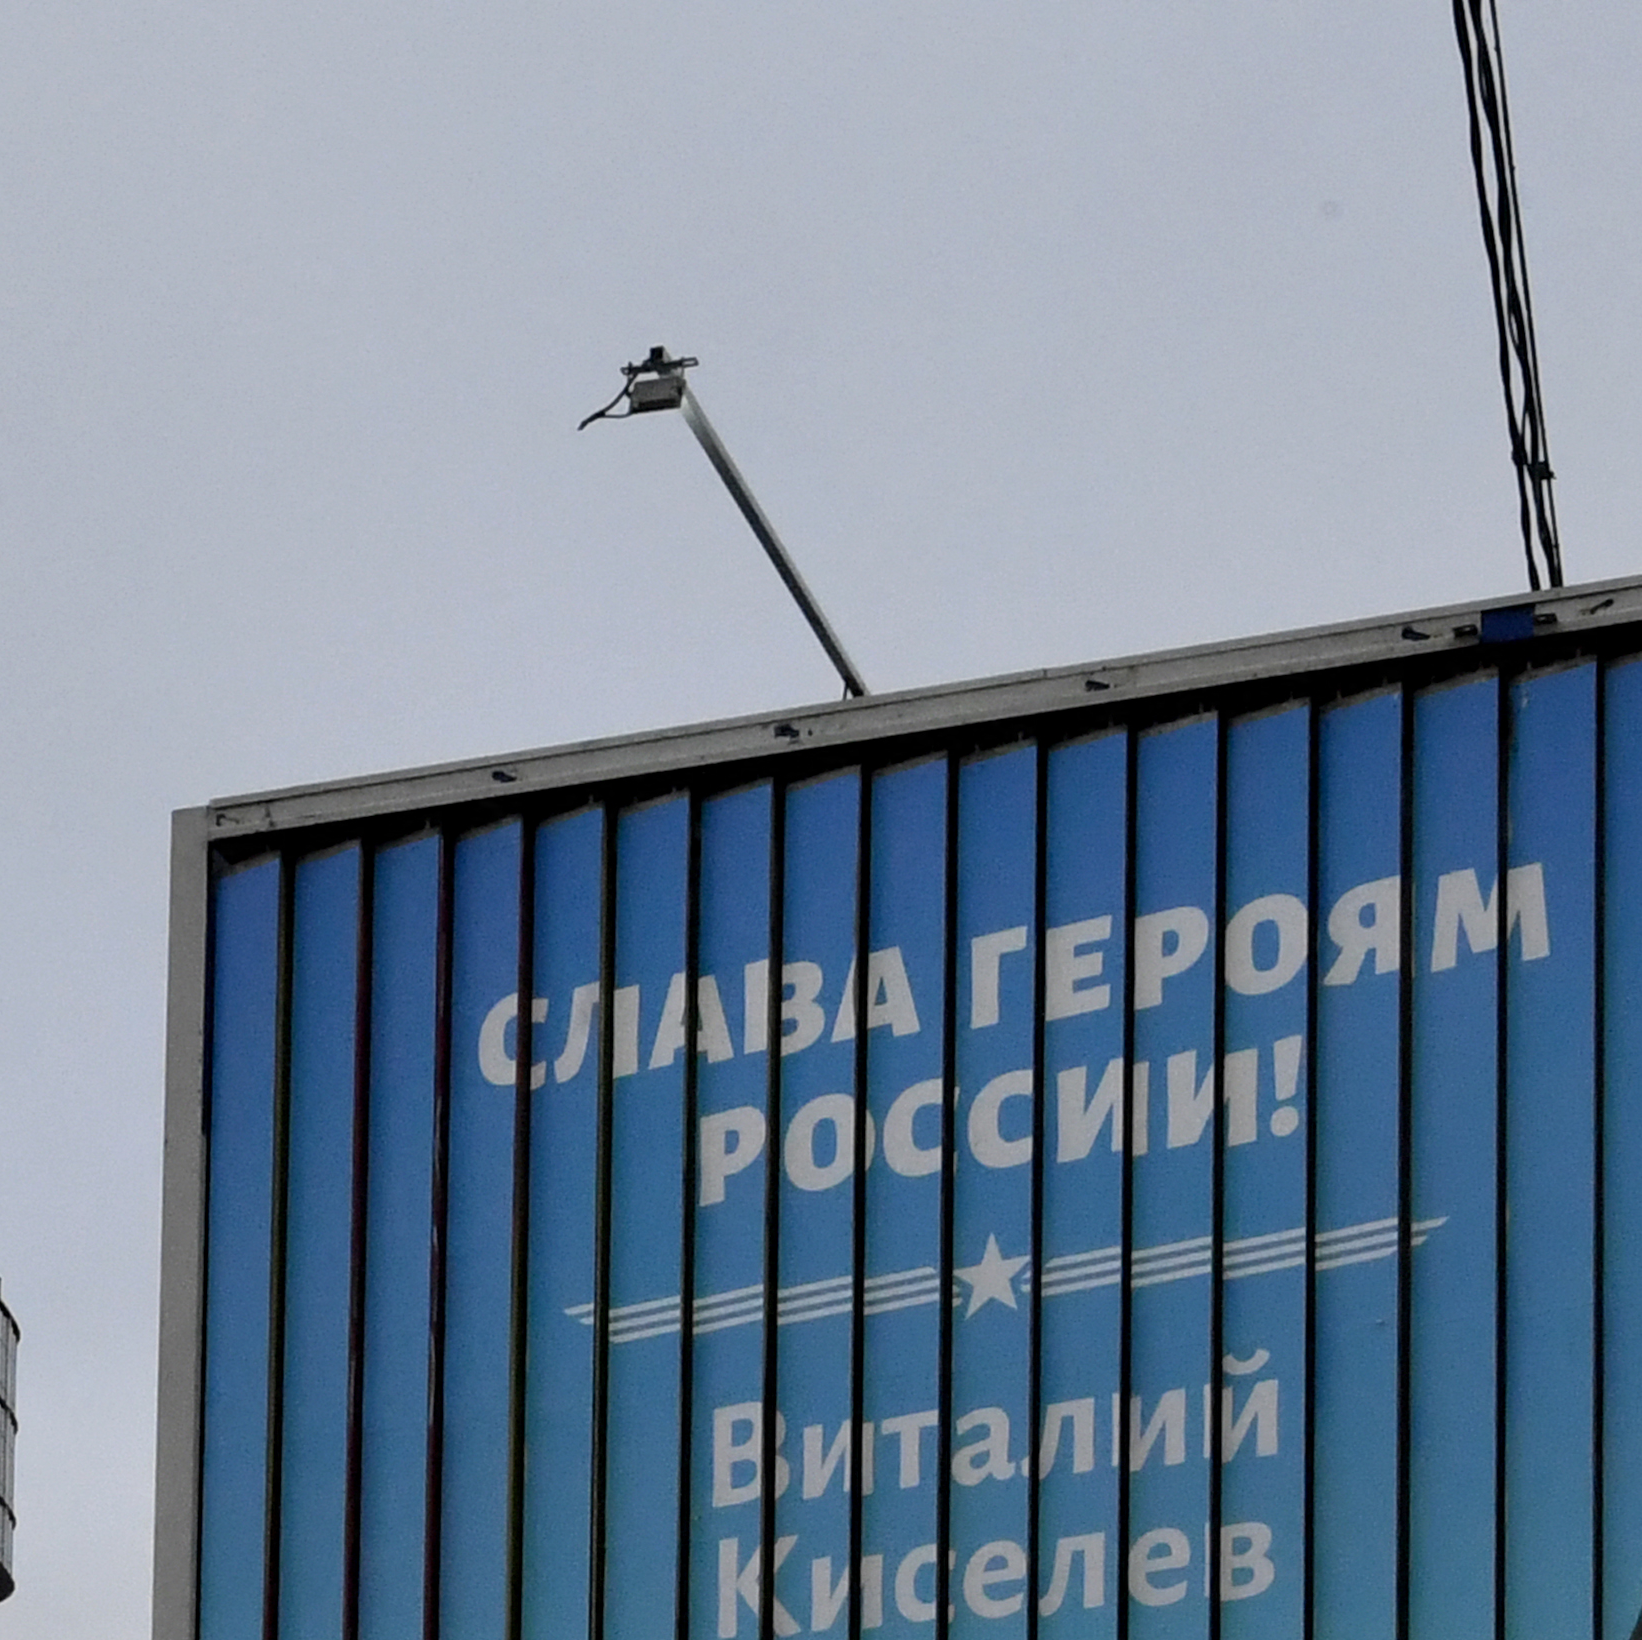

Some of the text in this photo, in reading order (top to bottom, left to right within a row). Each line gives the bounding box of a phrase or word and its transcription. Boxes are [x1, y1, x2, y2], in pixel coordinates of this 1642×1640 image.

[477, 862, 1550, 1090] СЛАВА ГЕРОЯМ
[698, 1034, 1305, 1206] РОССИИ!
[710, 1349, 1280, 1508] Виталий
[716, 1518, 1277, 1639] Киселев
